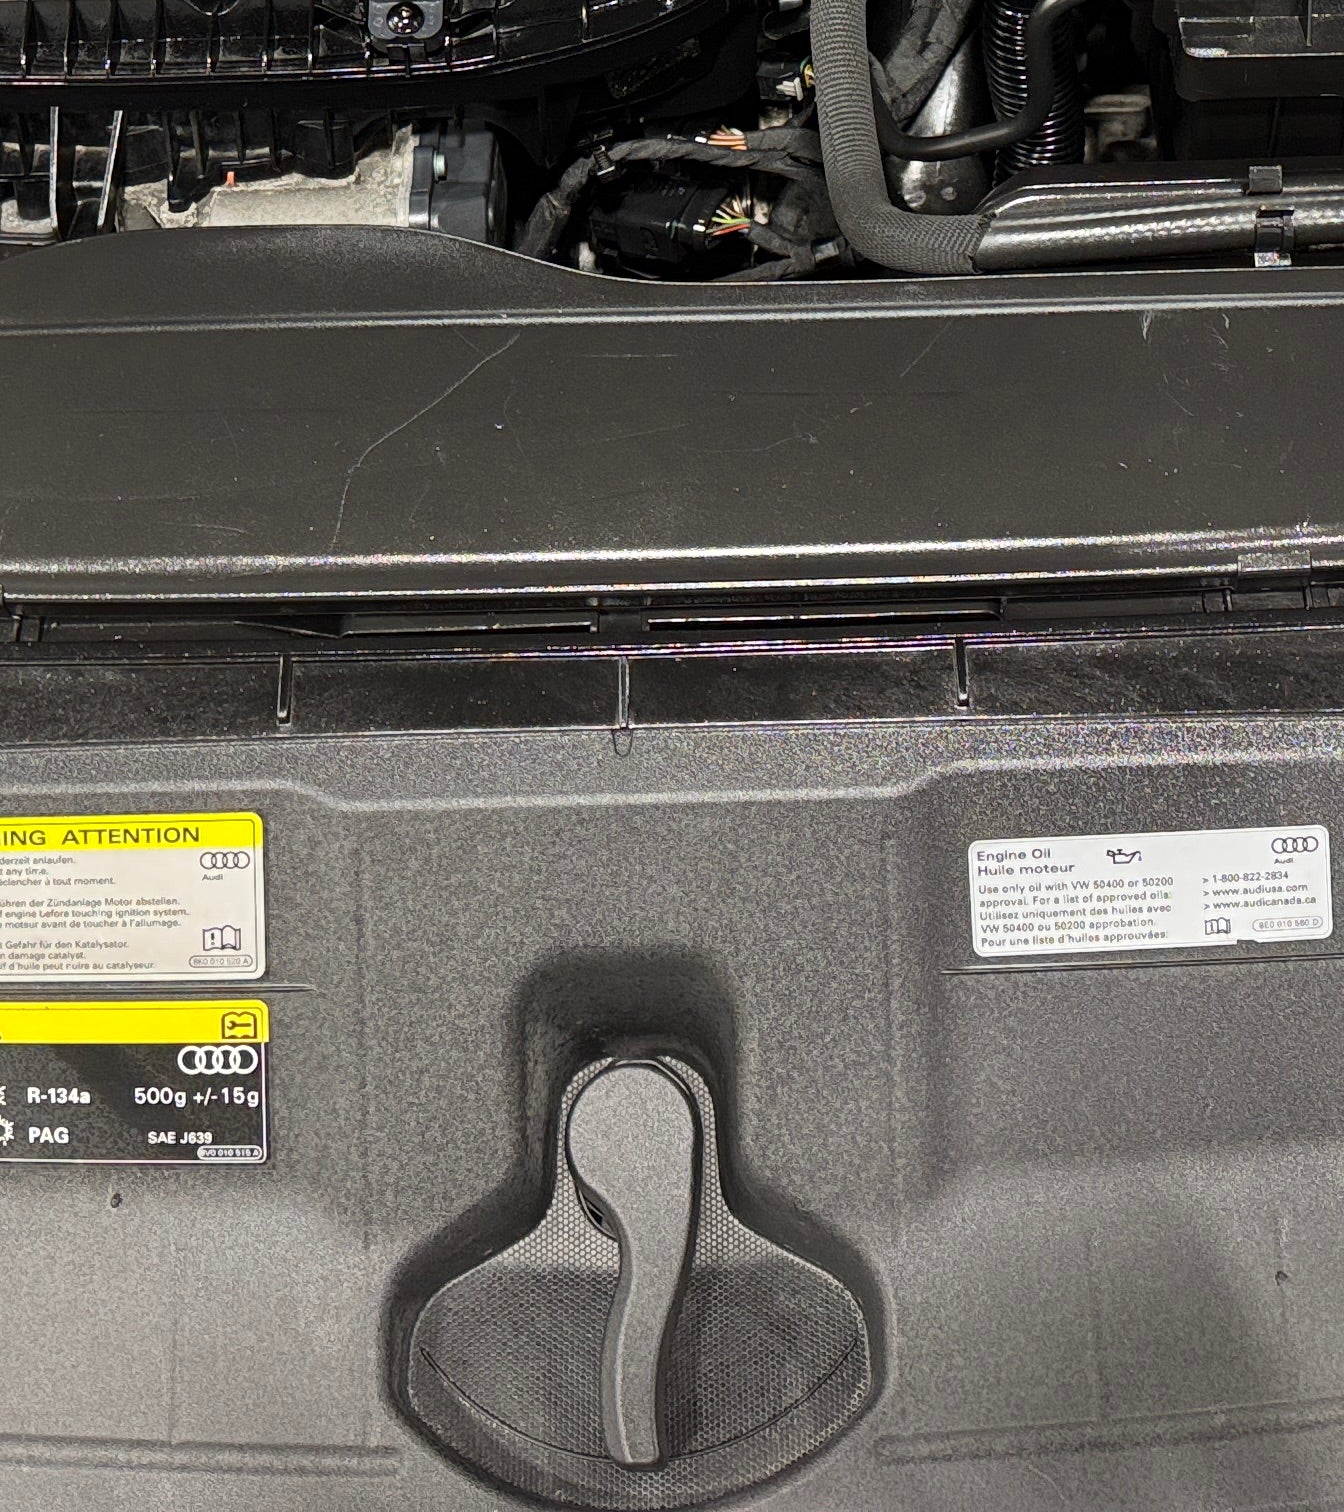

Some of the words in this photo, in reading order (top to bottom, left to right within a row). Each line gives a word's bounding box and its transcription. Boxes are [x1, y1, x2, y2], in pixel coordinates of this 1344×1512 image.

[61, 827, 201, 845] ATTENTION
[976, 850, 1027, 863] Engine
[1031, 848, 1051, 859] Oil
[6, 869, 23, 877] any
[977, 866, 1014, 877] Huile
[1019, 864, 1075, 875] moteur
[53, 878, 72, 886] tout
[74, 877, 116, 885] moment.
[1212, 871, 1289, 883] 1-800-822-2834
[979, 885, 999, 894] Use
[1001, 884, 1024, 895] only
[1028, 883, 1042, 892] oil
[1044, 883, 1068, 892] with
[1071, 881, 1090, 890] VW
[1093, 880, 1124, 890] 50400
[1128, 880, 1139, 888] or
[1142, 877, 1174, 887] 50200
[1212, 884, 1308, 896] www.audiusa.com
[28, 899, 44, 907] der
[47, 898, 102, 908] Zündanlage
[105, 898, 133, 906] Motor
[1032, 896, 1051, 906] For
[1063, 894, 1080, 904] list
[1082, 894, 1094, 903] of
[1096, 892, 1147, 905] approved
[1212, 896, 1316, 909] www.audicanada.ca
[5, 911, 37, 919] engine
[71, 909, 113, 919] touching
[115, 908, 151, 918] ignition
[980, 911, 1019, 921] Utilisez
[1022, 908, 1086, 921] uniquement
[1089, 906, 1109, 916] des
[1111, 905, 1144, 915] huiles
[1146, 905, 1172, 913] avec
[40, 921, 67, 929] avant
[69, 920, 81, 928] de
[83, 919, 119, 928] toucher
[981, 924, 1000, 934] VW
[1003, 923, 1035, 933] 50400
[1037, 923, 1052, 932] ou
[1054, 921, 1086, 931] 50200
[5, 940, 37, 949] Gefahr
[39, 940, 53, 948] für
[55, 941, 72, 949] den
[981, 937, 1006, 947] Pour
[1009, 937, 1030, 946] une
[1032, 935, 1055, 945] liste
[8, 952, 45, 961] damage
[43, 963, 63, 972] peut
[27, 1087, 91, 1105] R-134a
[134, 1087, 187, 1108] 500g
[28, 1126, 70, 1144] PAG
[148, 1130, 176, 1144] SAE
[180, 1131, 213, 1144] J639
